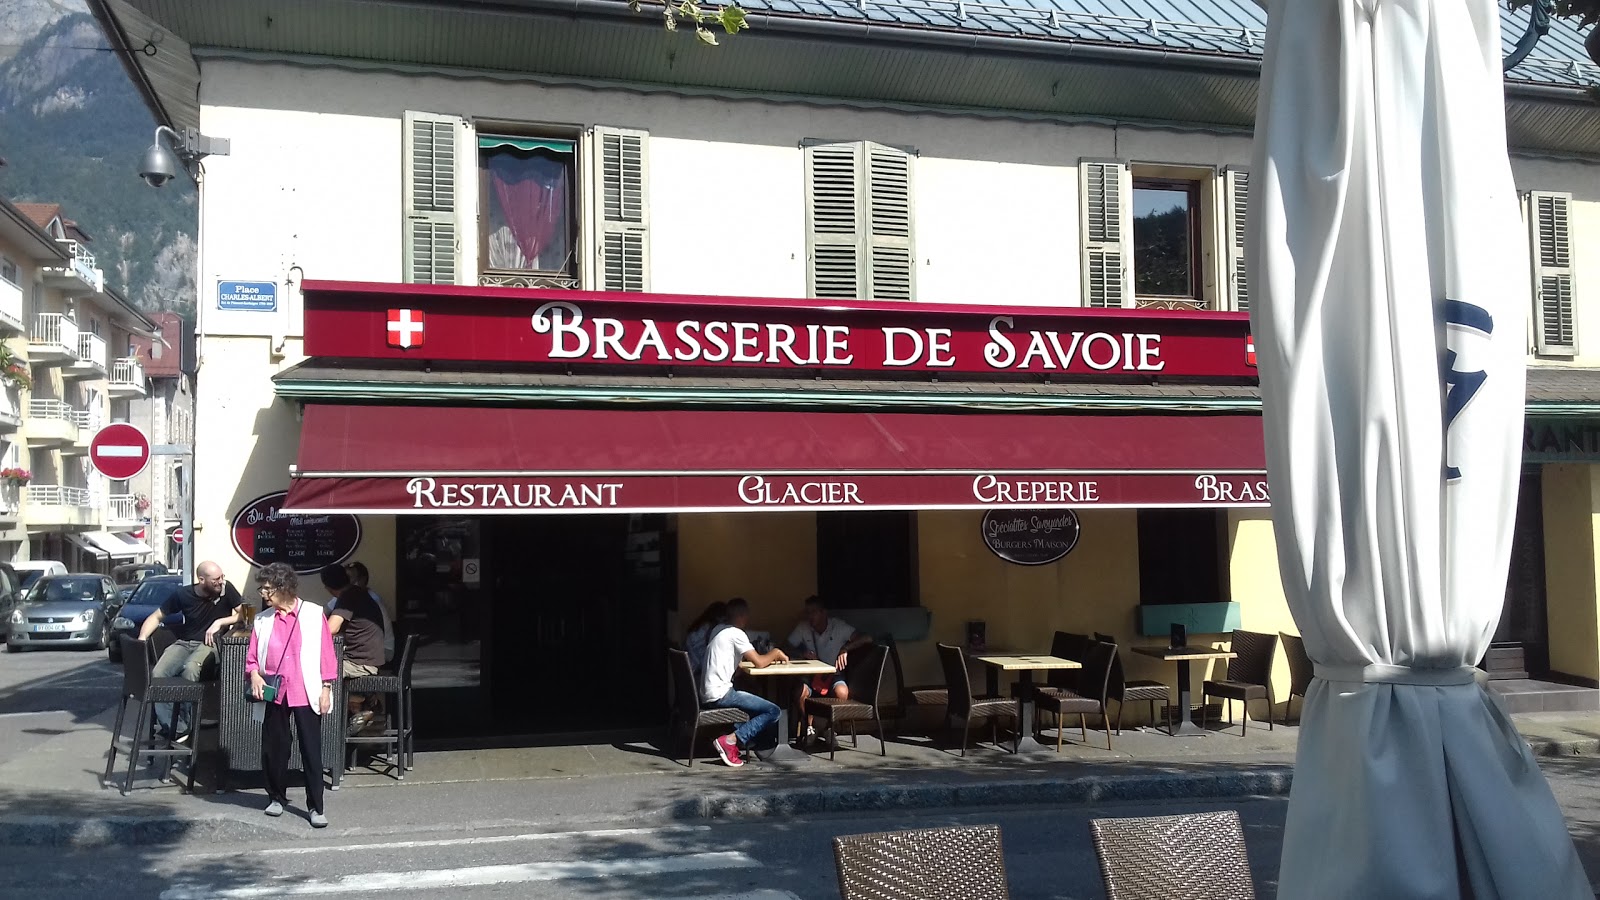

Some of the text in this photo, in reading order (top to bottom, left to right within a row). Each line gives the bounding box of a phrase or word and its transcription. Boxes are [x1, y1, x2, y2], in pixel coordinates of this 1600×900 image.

[221, 293, 274, 301] CHARLES-ALBERT
[235, 285, 259, 293] Place
[531, 302, 1165, 371] BRASSERIE DE SAVOIE
[406, 477, 623, 508] RESTAURANT
[738, 475, 864, 504] GLACIER
[972, 474, 1099, 503] CREPERIE
[992, 539, 1069, 549] BURGERS MAISON
